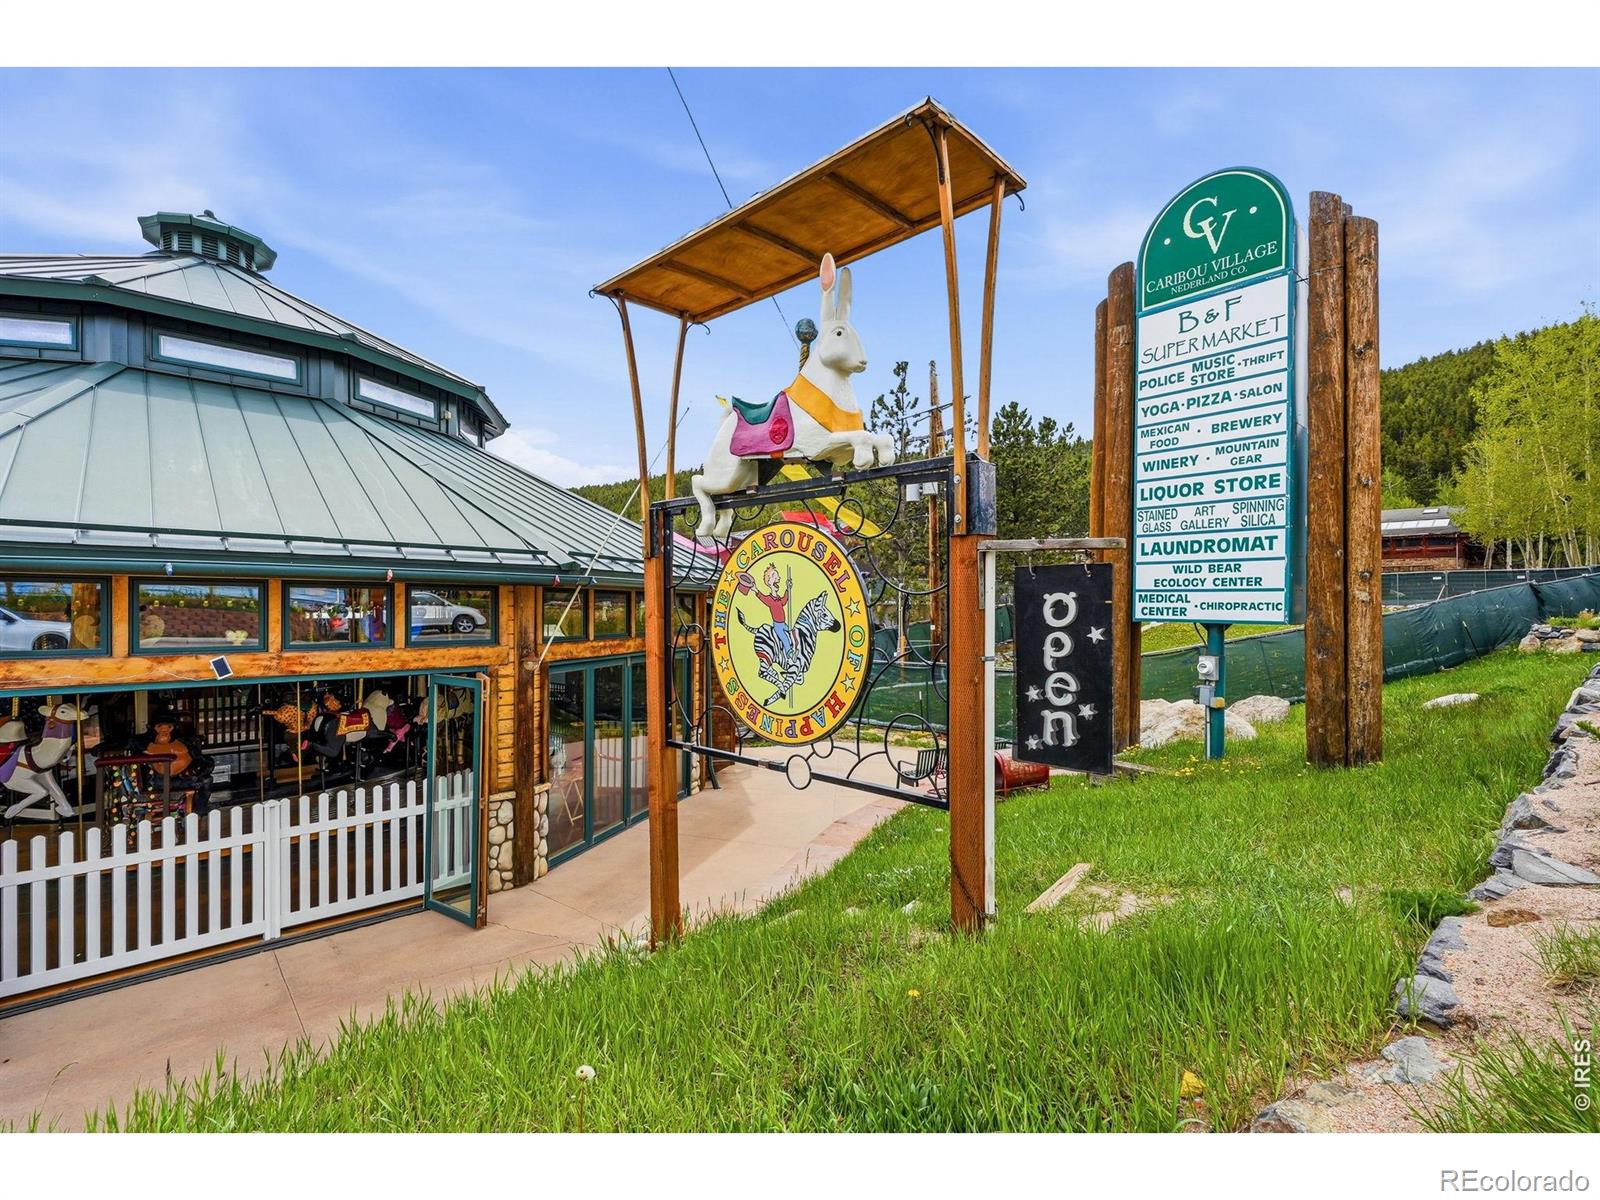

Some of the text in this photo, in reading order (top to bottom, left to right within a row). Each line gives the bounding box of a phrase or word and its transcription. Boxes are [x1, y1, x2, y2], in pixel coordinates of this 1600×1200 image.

[1146, 240, 1278, 293] CARIBOU VILLAGE
[1171, 264, 1248, 295] NEDERLAND CO.
[1178, 295, 1242, 334] B & F
[1191, 350, 1285, 373] MUSIC THRIFT
[1139, 366, 1236, 391] POLICE STORE
[1141, 382, 1283, 418] YOGA PIZZA SALON
[1140, 422, 1190, 438] MEXICAN
[1211, 412, 1283, 434] BREWERY
[1150, 437, 1179, 449] FOOD
[1215, 438, 1279, 455] MOUNTAIN
[1142, 454, 1199, 472] WINERY
[1230, 453, 1263, 466] GEAR
[1140, 473, 1281, 501] LIQUOR STORE
[1137, 508, 1178, 522] STAINED
[1194, 505, 1216, 517] ART
[1232, 499, 1285, 515] SPINNING
[1142, 521, 1172, 533] GLASS
[1180, 517, 1230, 530] GALLERY
[1240, 513, 1276, 527] SILICA
[1140, 535, 1278, 556] LAUNDROMAT
[1172, 563, 1242, 574] WILD BEAR
[1153, 576, 1263, 588] ECOLOGY CENTER
[1138, 593, 1191, 604] MEDICAL
[1199, 602, 1283, 611] CHIROPRACTIC
[1141, 606, 1188, 617] CENTER
[713, 529, 866, 739] THE CAROUSEL OF HAPPINESS
